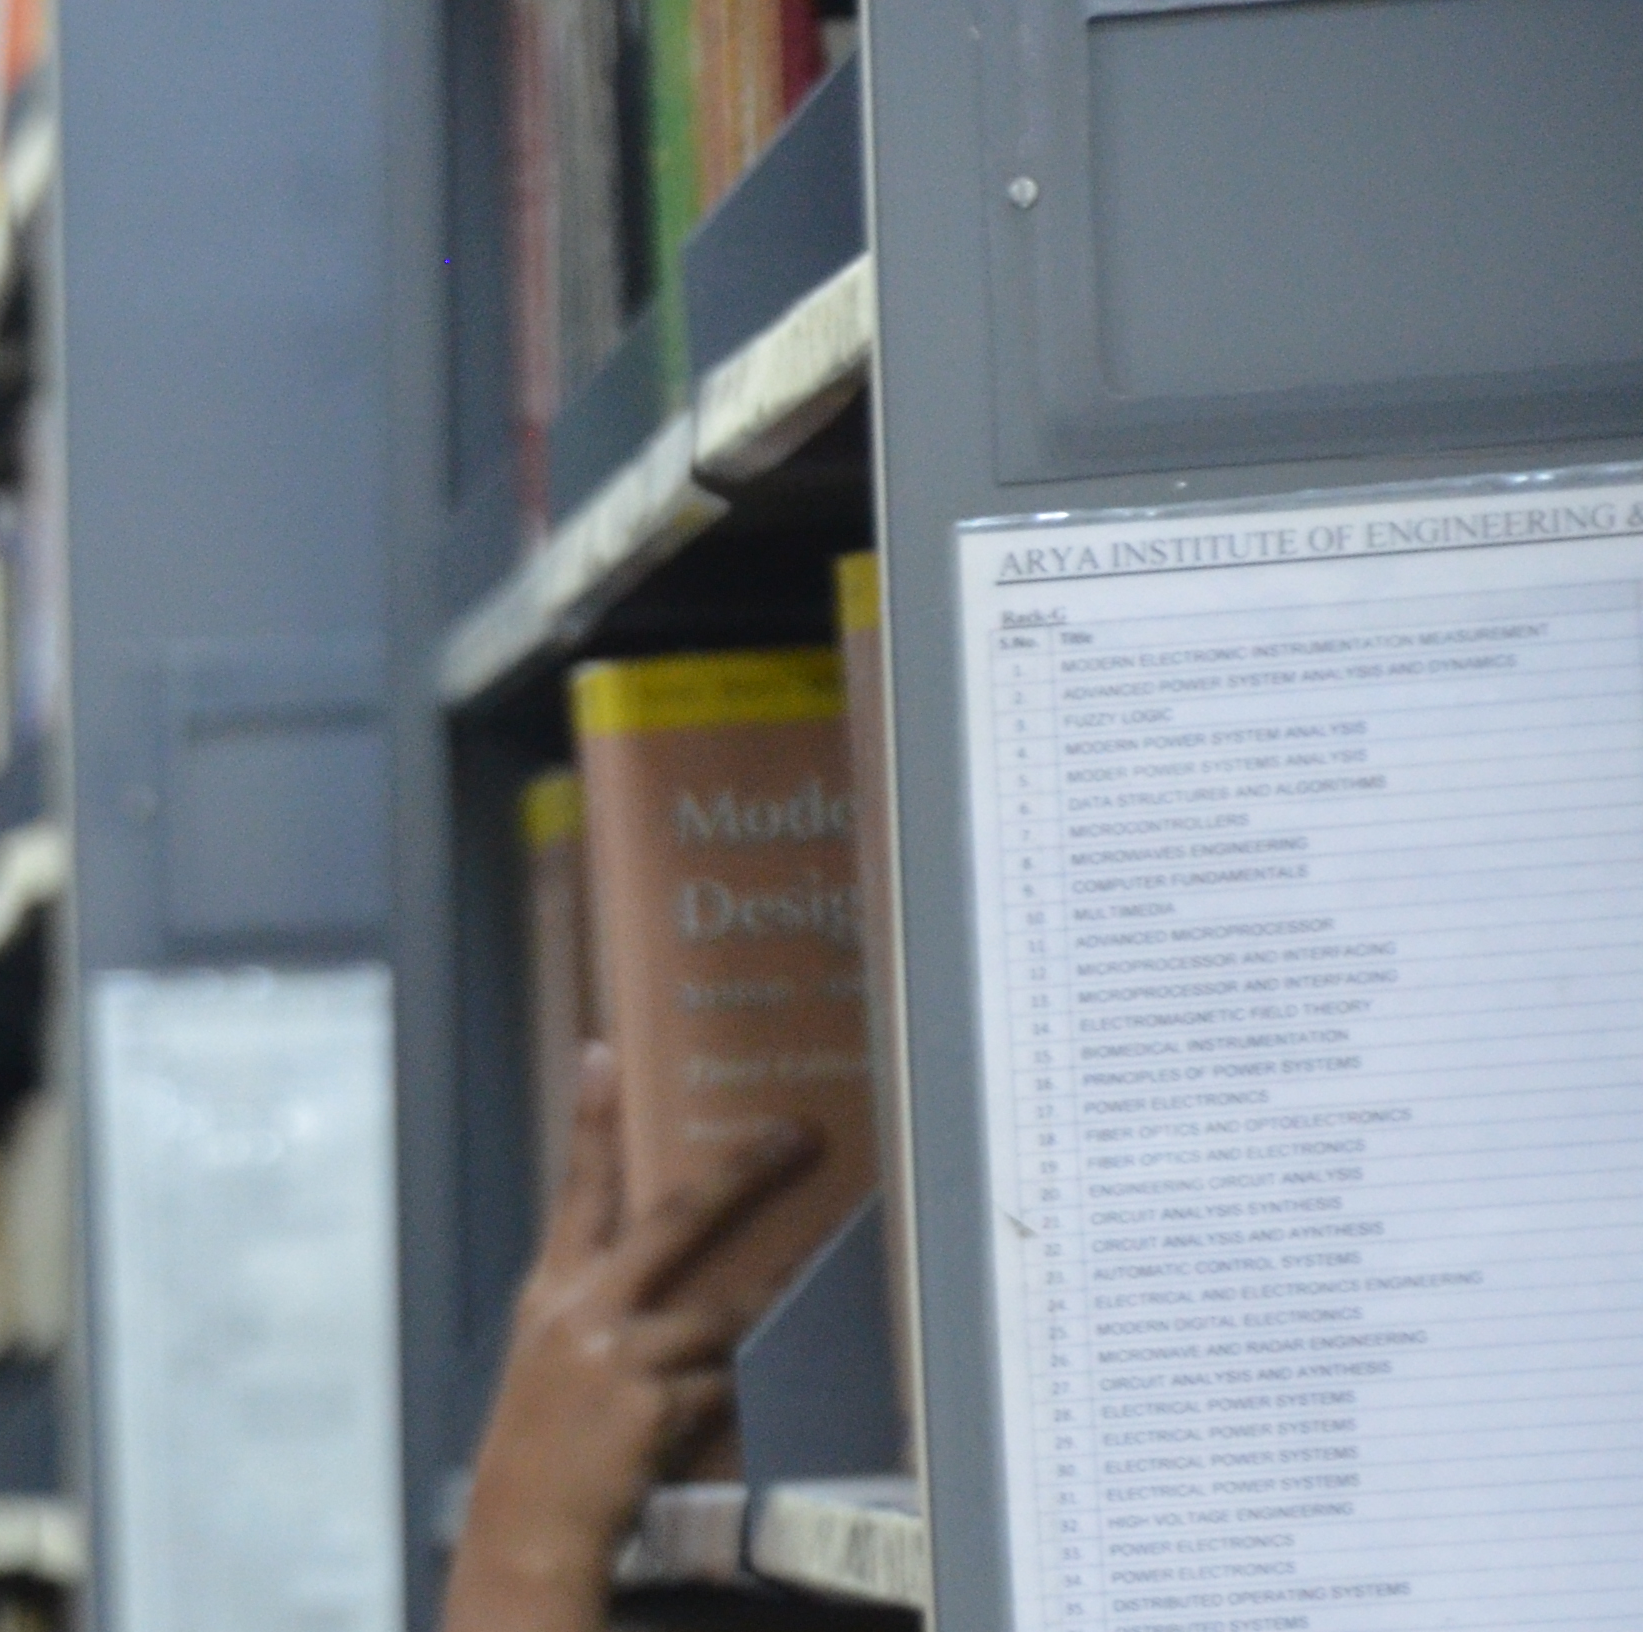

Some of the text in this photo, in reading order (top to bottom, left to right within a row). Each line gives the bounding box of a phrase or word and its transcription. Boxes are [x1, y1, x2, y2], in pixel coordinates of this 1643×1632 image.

[999, 545, 1100, 577] ARYA
[1113, 529, 1297, 568] INSTITUTE
[1307, 523, 1355, 552] OF
[1365, 502, 1616, 548] ENGINEERING
[1061, 654, 1135, 674] MODERN
[1141, 646, 1247, 668] ELECTRONIC
[1419, 622, 1550, 646] MEASUREMENT
[1062, 631, 1093, 646] Title
[1063, 680, 1154, 701] ADVANCED
[1160, 675, 1222, 694] POWER
[1228, 670, 1297, 689] SYSTEM
[1303, 663, 1384, 683] ANALYSIS
[1390, 660, 1424, 677] AND
[1064, 707, 1174, 729] FUZZY LOGIC
[1064, 720, 1369, 757] MODERN POWER SYSTEM ANALYSIS
[1134, 761, 1196, 779] POWER
[1202, 754, 1281, 774] SYSTEMS
[1287, 748, 1369, 768] ANALYSIS
[1068, 774, 1387, 812] DATA STRUCTURES AND ALGORITHMS
[1069, 812, 1250, 840] MICROCONTROLLERS
[1192, 836, 1309, 858] ENGINEERING
[1072, 864, 1309, 894] COMPUTER FUNDAMENTALS
[1073, 901, 1176, 922] MULTIMEDIA
[1076, 917, 1336, 950] ADVANCED MICROPROCESSOR
[1076, 941, 1397, 977] MICROPROCESSOR AND INTERFACING
[1077, 968, 1399, 1005] MICROPROCESSOR AND INTERFACING
[1079, 998, 1373, 1033] ELECTROMAGNETIC FIELD THEORY
[1080, 1039, 1181, 1060] BIOMEDICAL
[1083, 1055, 1362, 1088] PRINCIPLES OF POWER SYSTEMS
[1083, 1089, 1270, 1116] POWER ELECTRONICS
[1085, 1126, 1134, 1143] FIBER
[1140, 1121, 1200, 1139] OPTICS
[1206, 1119, 1240, 1135] AND
[1087, 1138, 1367, 1171] FIBER OPTICS AND ELECTRONICS
[1088, 1166, 1364, 1199] ENGINEERING CIRCUIT ANALYSIS
[1091, 1195, 1343, 1226] CIRCUIT ANALYSIS SYNTHESIS
[1092, 1236, 1158, 1254] CIRCUIT
[1164, 1230, 1245, 1249] ANALYSIS
[1251, 1227, 1285, 1243] AND
[1093, 1250, 1362, 1282] AUTOMATIC CONTROL SYSTEMS
[1094, 1270, 1484, 1310] ELECTRICAL AND ELECTRONICS ENGINEERING
[1095, 1306, 1364, 1337] MODERN DIGITAL ELECTRONICS
[1097, 1330, 1428, 1365] MICROWAVE AND RADAR ENGINEERING
[1100, 1374, 1166, 1393] CIRCUIT
[1172, 1369, 1253, 1388] ANALYSIS
[1259, 1366, 1293, 1382] AND
[1101, 1389, 1356, 1420] ELECTRICAL POWER SYSTEMS
[1102, 1416, 1358, 1447] ELECTRICAL POWER SYSTEMS
[1104, 1445, 1359, 1475] ELECTRICAL POWER SYSTEMS
[1105, 1472, 1361, 1502] ELECTRICAL POWER SYSTEMS
[1155, 1509, 1231, 1527] VOLTAGE
[1237, 1501, 1355, 1522] ENGINEERING
[1109, 1533, 1295, 1558] POWER ELECTRONICS
[1111, 1560, 1297, 1585] POWER ELECTRONICS
[1113, 1581, 1412, 1613] DISTRIBUTED OPERATING SYSTEMS
[1231, 1614, 1310, 1632] SYSTEMS
